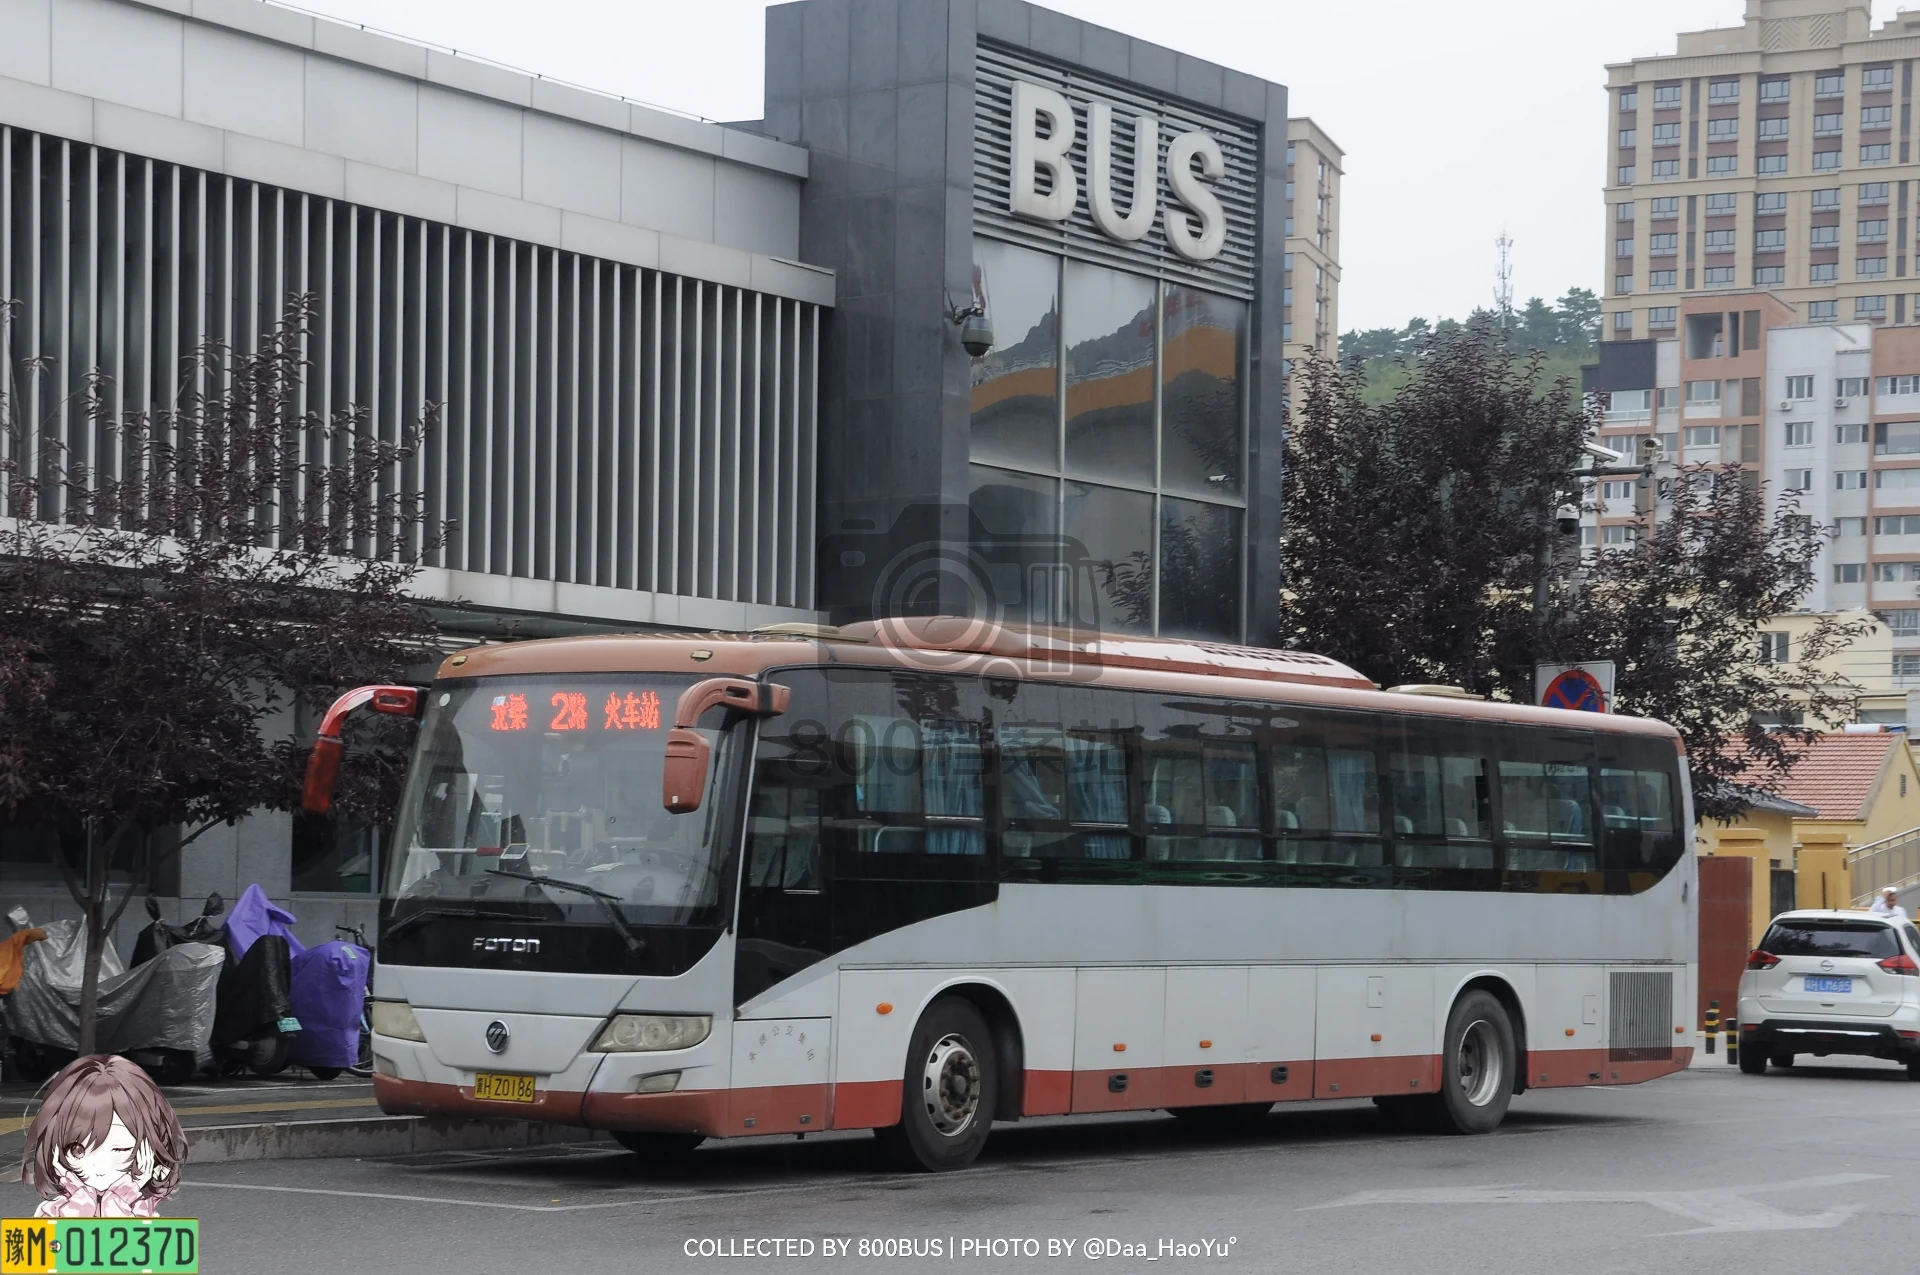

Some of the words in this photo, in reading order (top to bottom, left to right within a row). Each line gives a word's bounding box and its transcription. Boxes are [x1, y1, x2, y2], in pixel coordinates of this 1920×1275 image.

[1010, 80, 1227, 261] BUS
[551, 692, 588, 730] 2路
[605, 691, 660, 730] 火车站
[473, 938, 540, 953] FOTON
